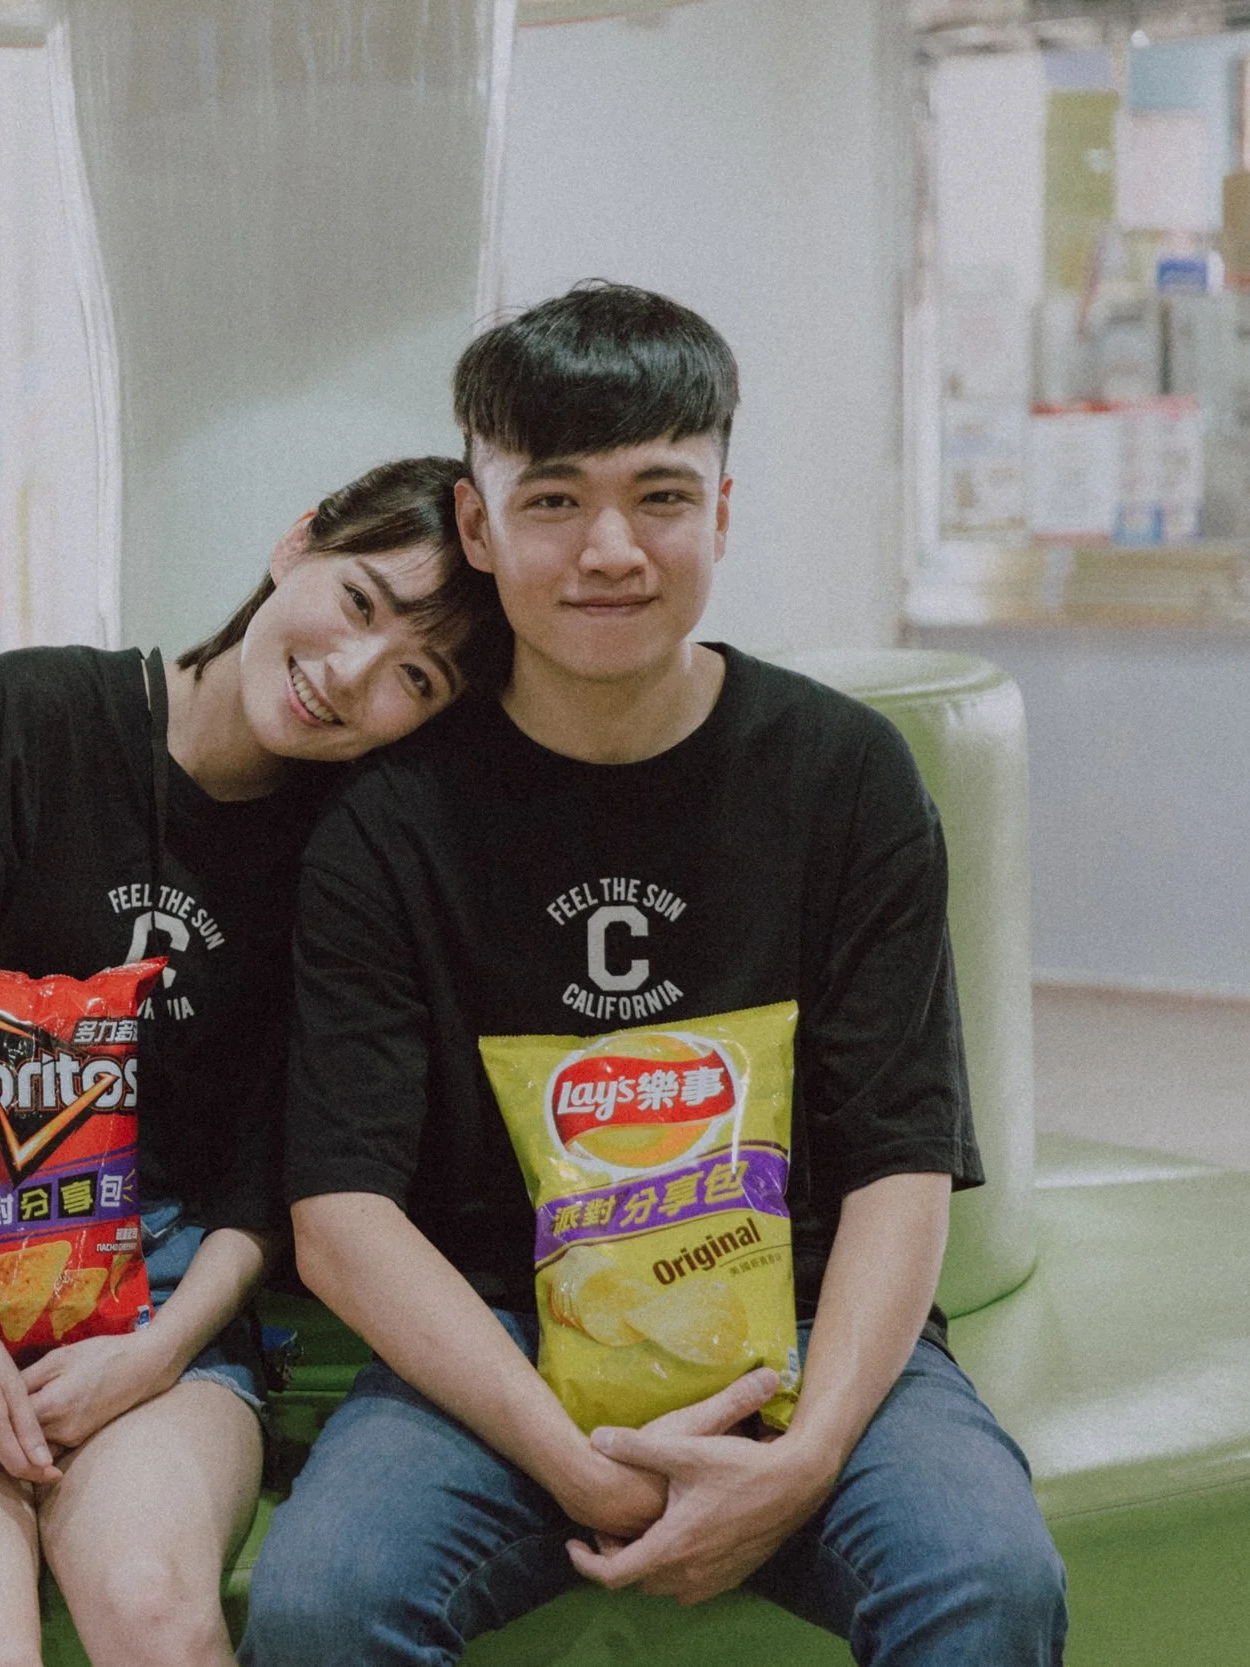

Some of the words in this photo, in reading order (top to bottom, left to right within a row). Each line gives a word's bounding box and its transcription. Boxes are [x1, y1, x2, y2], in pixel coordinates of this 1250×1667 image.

[107, 883, 153, 914] FEEL
[158, 885, 196, 919] THE
[191, 908, 226, 950] SUN
[546, 882, 599, 926] FEEL
[599, 877, 641, 903] THE
[642, 883, 688, 922] SUN
[587, 905, 650, 991] C
[561, 979, 684, 1021] CALIFORNIA
[557, 1075, 636, 1121] Lay's
[637, 1066, 725, 1111] 樂事
[652, 1217, 762, 1285] Original
